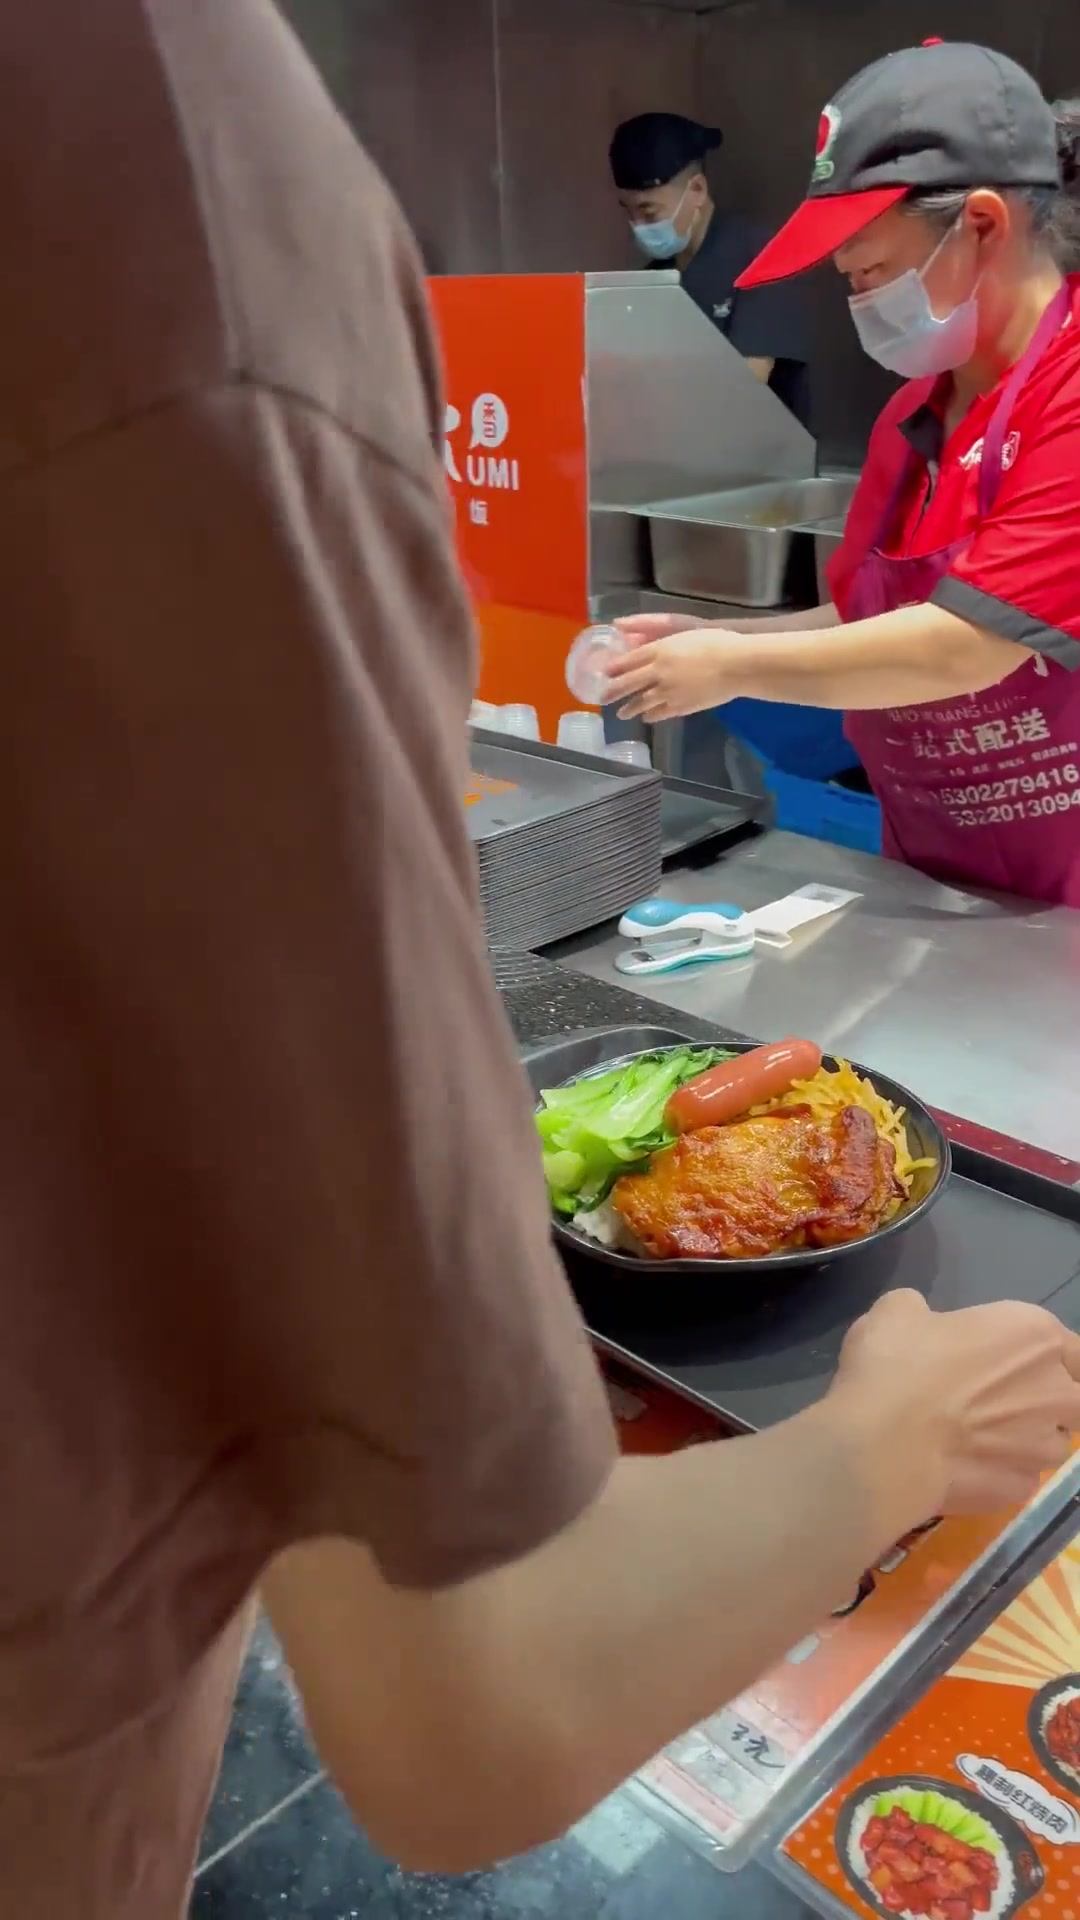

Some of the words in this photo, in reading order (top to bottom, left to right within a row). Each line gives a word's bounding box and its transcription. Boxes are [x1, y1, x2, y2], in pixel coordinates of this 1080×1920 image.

[886, 707, 1050, 759] 一站式配送
